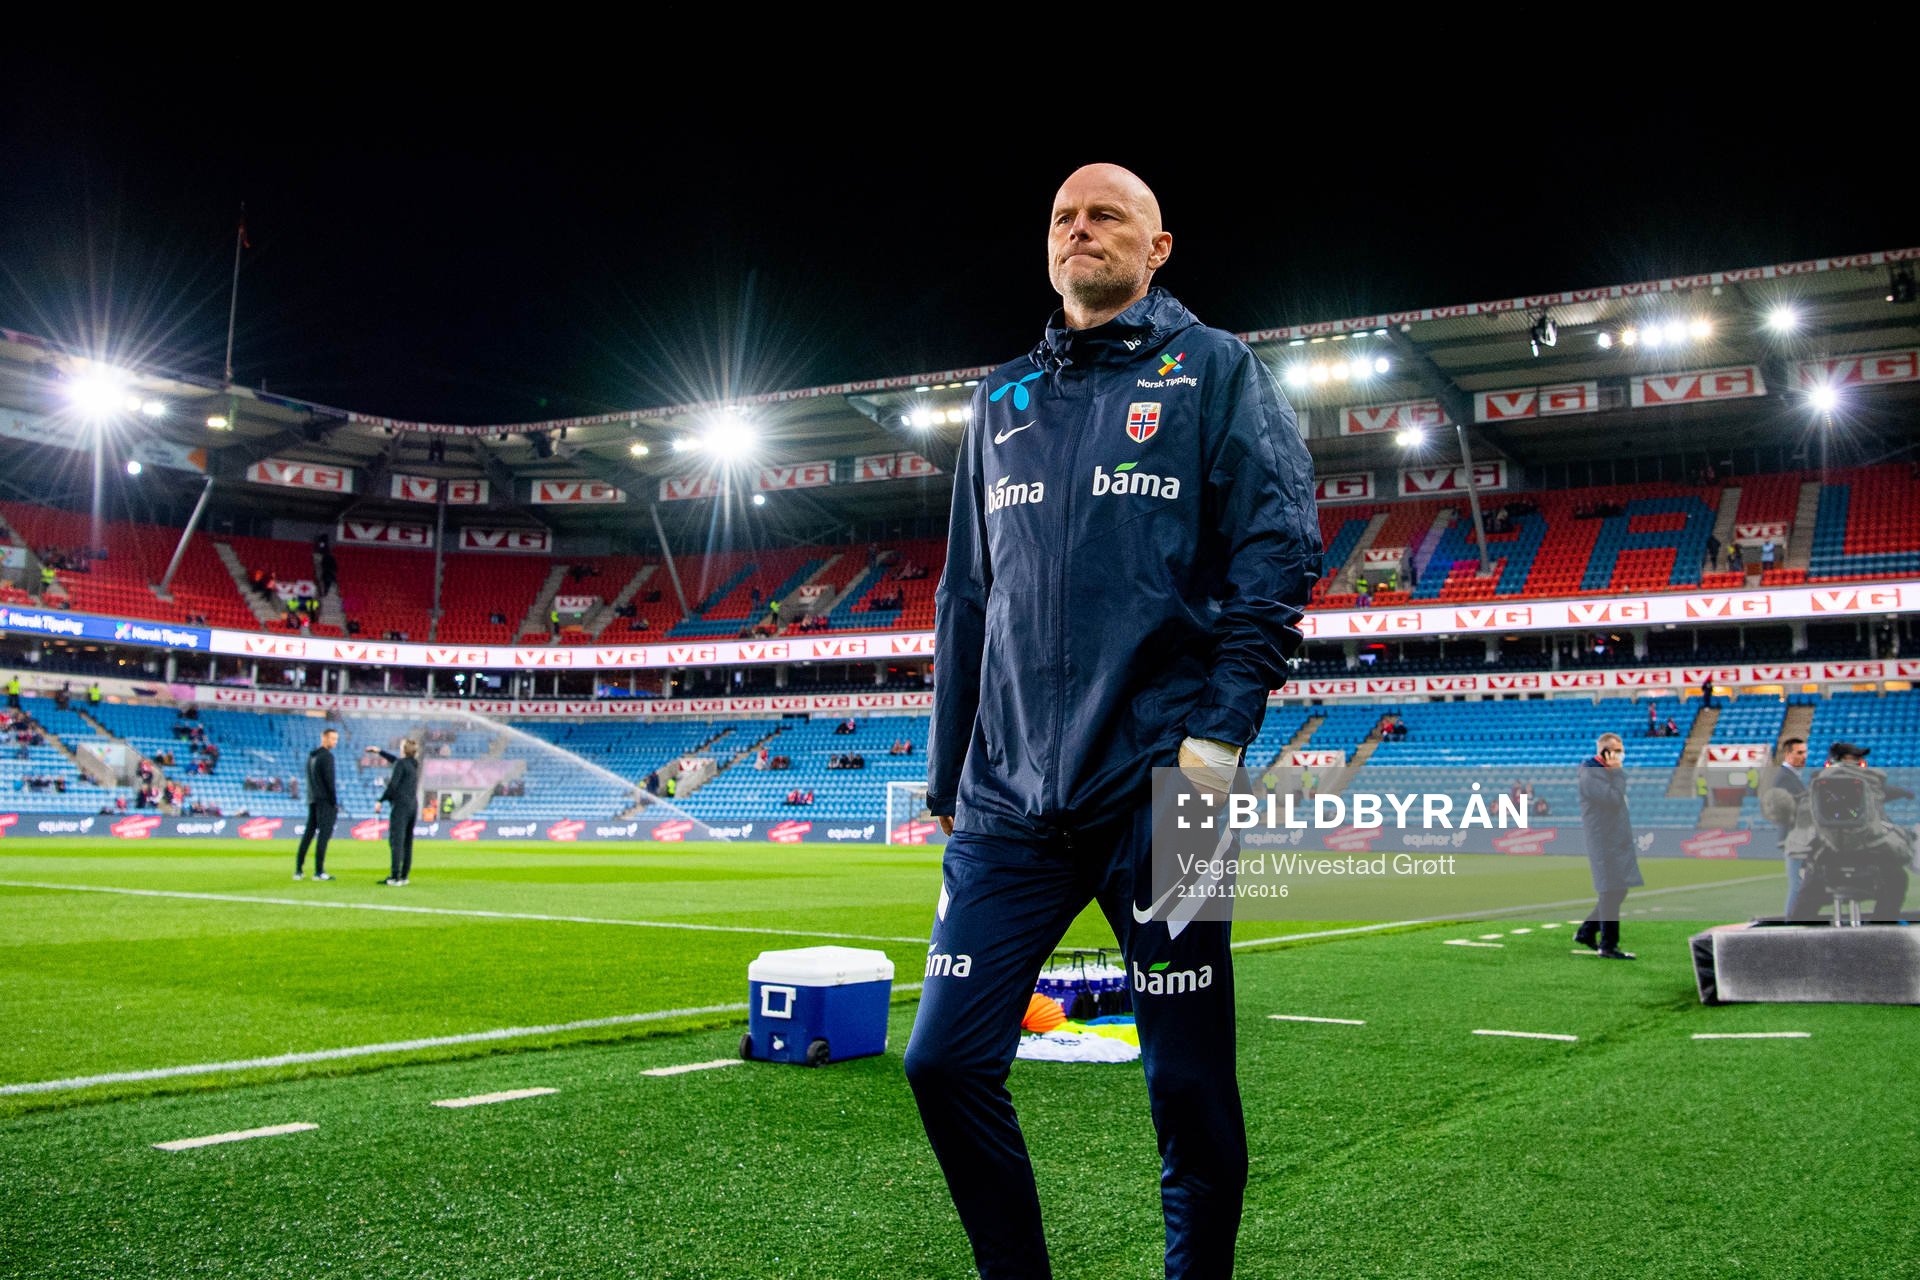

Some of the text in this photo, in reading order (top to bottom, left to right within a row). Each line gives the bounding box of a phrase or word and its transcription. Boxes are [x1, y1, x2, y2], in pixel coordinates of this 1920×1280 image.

[1776, 261, 1818, 277] VG
[1829, 254, 1873, 270] VG
[1671, 274, 1713, 289] VG
[1721, 268, 1764, 284] VG
[1571, 288, 1611, 301] VG
[1621, 282, 1661, 297] VG
[1477, 300, 1513, 313] VG
[1525, 293, 1562, 307] VG
[1387, 311, 1421, 323] VG
[1432, 305, 1468, 318] VG
[1300, 323, 1334, 335] VG
[1343, 317, 1376, 330] VG
[1259, 328, 1291, 341] VG
[1801, 351, 1918, 384] VG
[1137, 374, 1197, 389] Norsk Tipping
[1644, 368, 1755, 404] VG
[1486, 386, 1585, 419] VG
[1349, 403, 1445, 432] VG
[260, 461, 342, 492] VG
[761, 463, 831, 489] VG
[1092, 465, 1180, 500] bama
[1405, 464, 1500, 492] VG
[402, 476, 480, 503] VG
[988, 480, 1044, 514] bama
[342, 522, 425, 545] VG
[466, 529, 542, 550] VG
[1686, 595, 1771, 617] VG
[1811, 588, 1901, 612] VG
[1456, 607, 1531, 628] VG
[1568, 601, 1648, 622] VG
[1349, 612, 1421, 633] VG
[669, 647, 716, 664] VG
[739, 643, 789, 660] VG
[813, 640, 866, 657] VG
[516, 650, 572, 665] VG
[596, 649, 646, 664] VG
[1616, 671, 1671, 684] VG
[1684, 668, 1739, 683] VG
[1752, 666, 1811, 680] VG
[1824, 663, 1884, 679] VG
[1367, 679, 1415, 692] VG
[1427, 677, 1476, 690] VG
[1488, 675, 1539, 688] VG
[1551, 673, 1604, 687] VG
[1309, 682, 1356, 694] VG
[520, 701, 558, 713] VG
[566, 701, 601, 713] VG
[609, 702, 643, 713] VG
[652, 701, 682, 712] VG
[691, 700, 723, 712] VG
[730, 699, 765, 711] VG
[772, 698, 806, 710] VG
[814, 696, 849, 708] VG
[858, 695, 894, 707] VG
[1293, 753, 1338, 766] VG
[1708, 748, 1763, 762] VG
[827, 827, 863, 840] equinor
[1244, 833, 1289, 846] equinor
[1403, 834, 1450, 848] equinor
[1132, 961, 1214, 995] bama
